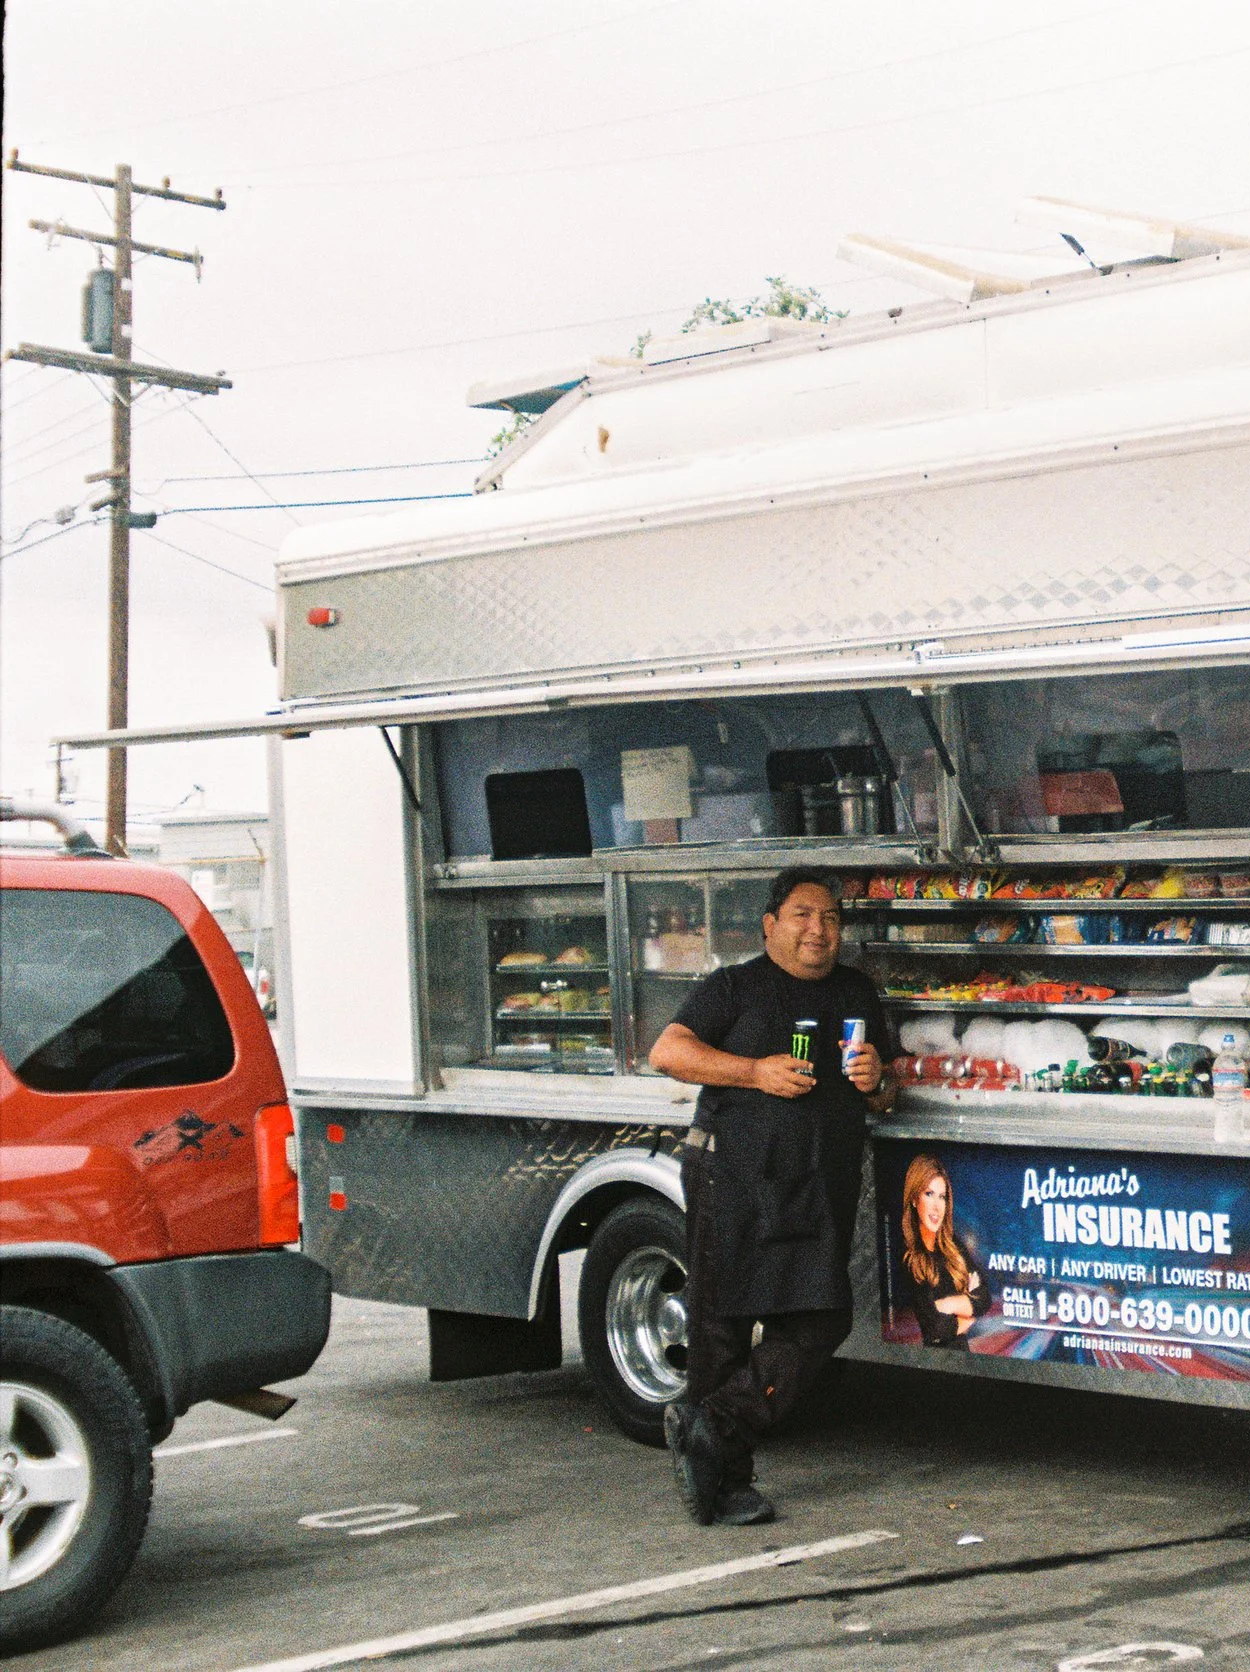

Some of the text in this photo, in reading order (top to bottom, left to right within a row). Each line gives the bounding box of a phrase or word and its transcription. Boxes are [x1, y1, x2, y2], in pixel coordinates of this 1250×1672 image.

[1021, 1166, 1140, 1209] Adriana's
[1043, 1203, 1232, 1255] INSURANCE
[988, 1254, 1016, 1272] ANY
[1018, 1256, 1046, 1275] CAR
[1061, 1259, 1093, 1278] ANY
[1094, 1262, 1146, 1282] DRIVER
[1162, 1266, 1223, 1289] LOWEST
[1003, 1286, 1034, 1304] CALL
[1016, 1303, 1034, 1319] TEXT
[1063, 1334, 1192, 1360] adrianasinsurance.com
